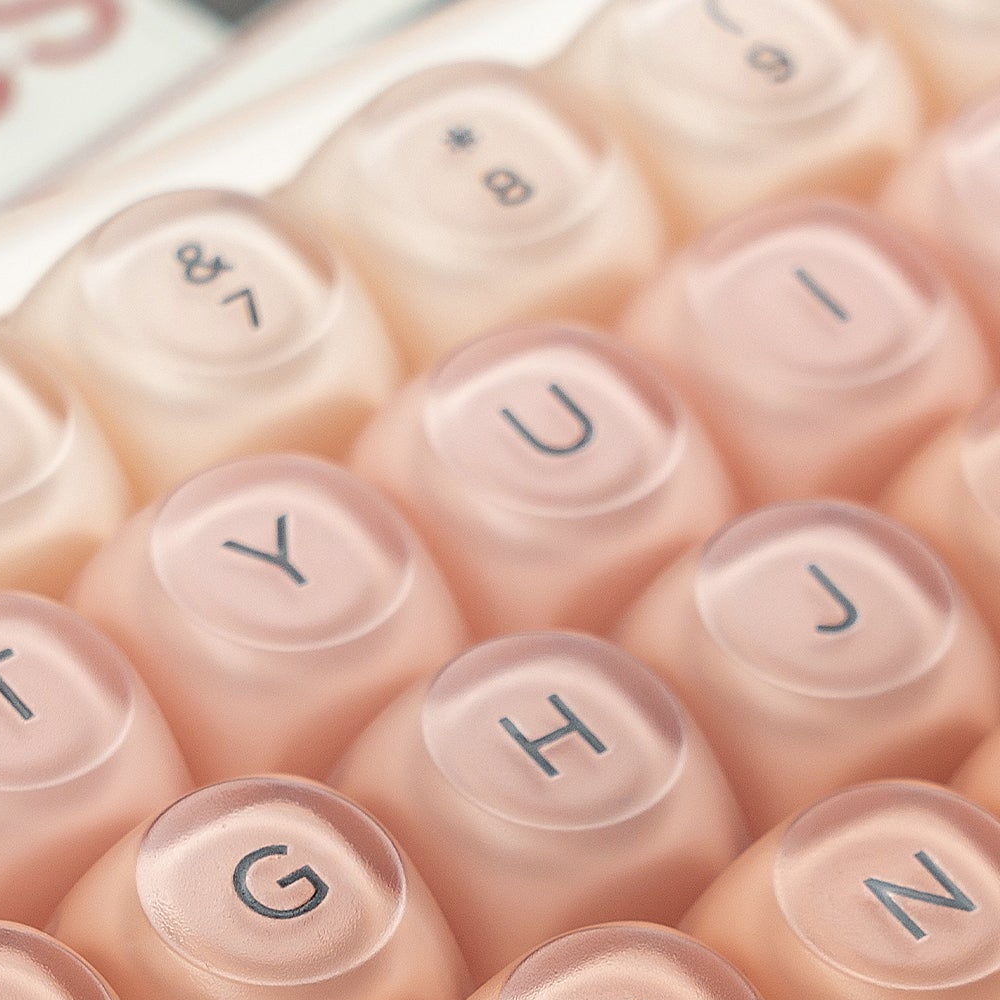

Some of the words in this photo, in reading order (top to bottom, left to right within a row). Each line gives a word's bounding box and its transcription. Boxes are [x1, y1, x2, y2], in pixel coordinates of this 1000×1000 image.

[483, 169, 534, 207] 8
[176, 244, 231, 285] &
[795, 268, 849, 323] I
[223, 287, 260, 328] 7
[501, 384, 594, 457] U
[222, 514, 307, 585] Y
[809, 564, 859, 633] J
[499, 694, 607, 777] H
[232, 844, 330, 920] G
[863, 850, 975, 940] N
